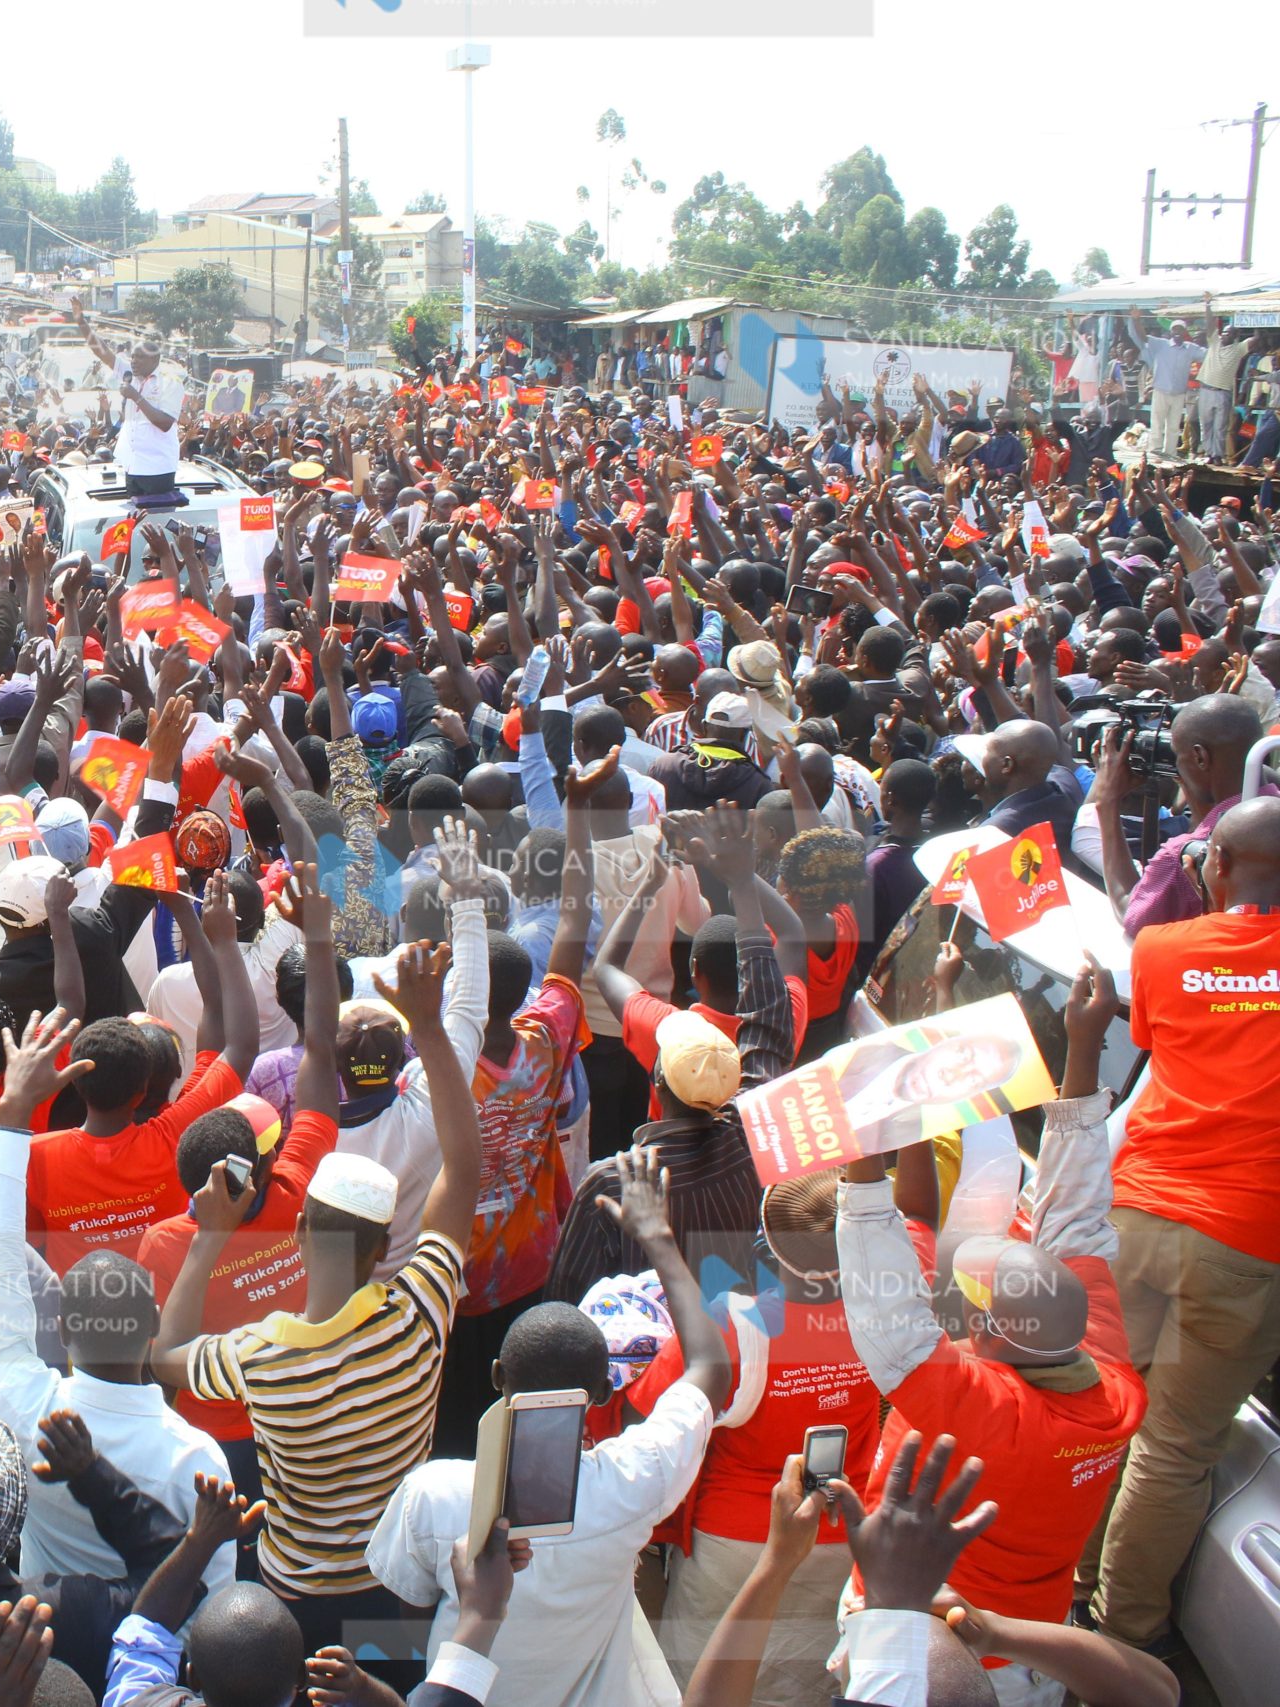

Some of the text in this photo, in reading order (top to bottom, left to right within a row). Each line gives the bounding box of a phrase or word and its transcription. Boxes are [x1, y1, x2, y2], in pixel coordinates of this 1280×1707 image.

[243, 505, 271, 515] TUKO
[339, 565, 387, 582] TUKO
[336, 579, 383, 591] PAMOJA
[446, 601, 462, 613] KO
[112, 761, 138, 809] Jubilee
[151, 852, 166, 891] ubilee
[1212, 966, 1233, 975] The
[1182, 969, 1280, 993] Stand
[1210, 1002, 1236, 1013] Feel
[1238, 1001, 1260, 1012] The
[351, 1064, 368, 1072] DON'T
[781, 1096, 815, 1168] OMBASA
[47, 1181, 168, 1218] JubileePamoja.co.ke
[69, 1204, 156, 1233] #TukoPamoja
[84, 1222, 152, 1244] SMS 30553
[232, 1250, 303, 1289] #TukoPam
[248, 1268, 307, 1302] SMS 3055
[782, 1367, 806, 1378] Don't
[808, 1367, 820, 1375] let
[821, 1364, 837, 1372] the
[773, 1379, 792, 1387] that
[793, 1377, 810, 1387] you
[812, 1373, 834, 1383] can't
[790, 1386, 816, 1396] doing
[817, 1382, 832, 1391] the
[833, 1378, 861, 1388] things
[818, 1389, 849, 1403] GoodLife
[818, 1398, 849, 1410] FITNESS
[1072, 1468, 1095, 1488] SMS
